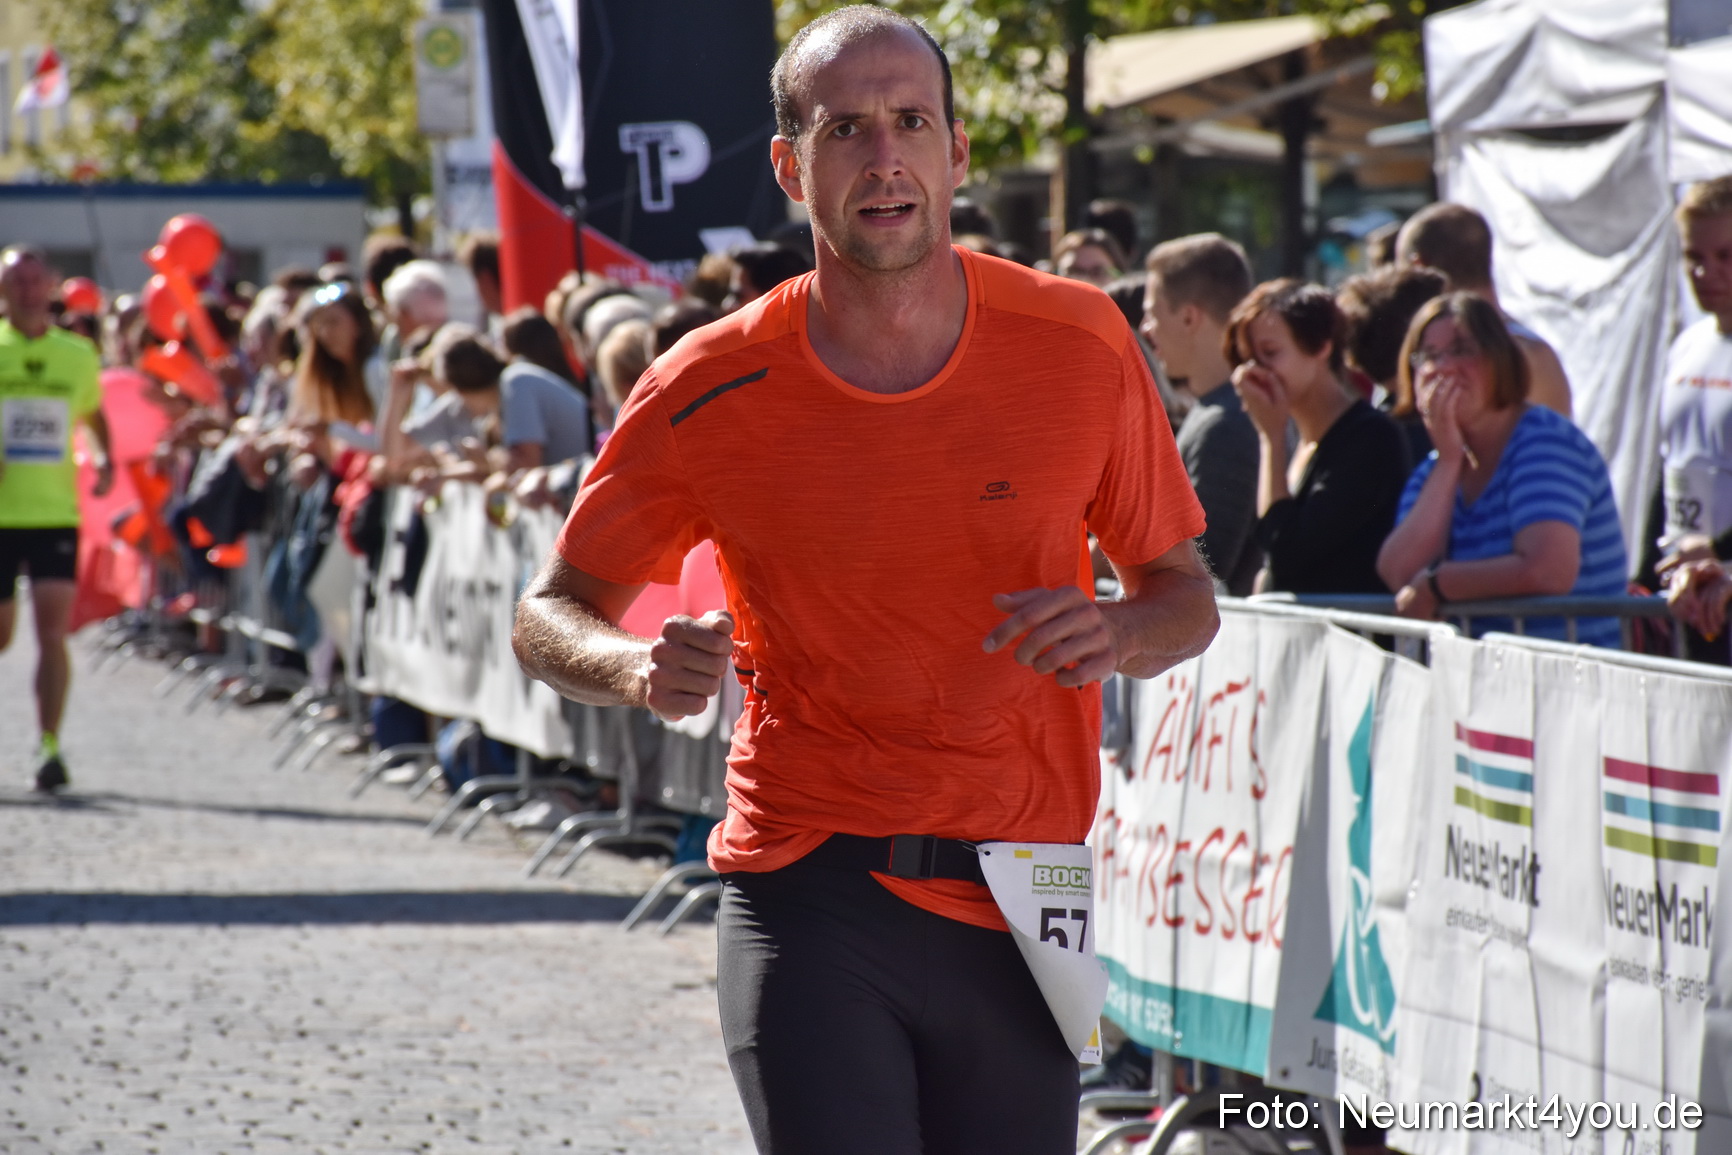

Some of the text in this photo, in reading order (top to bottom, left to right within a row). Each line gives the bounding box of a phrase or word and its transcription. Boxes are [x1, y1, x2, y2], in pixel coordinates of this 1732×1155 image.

[1032, 864, 1091, 889] BOCK
[1031, 887, 1059, 896] inspired
[1057, 888, 1065, 897] by
